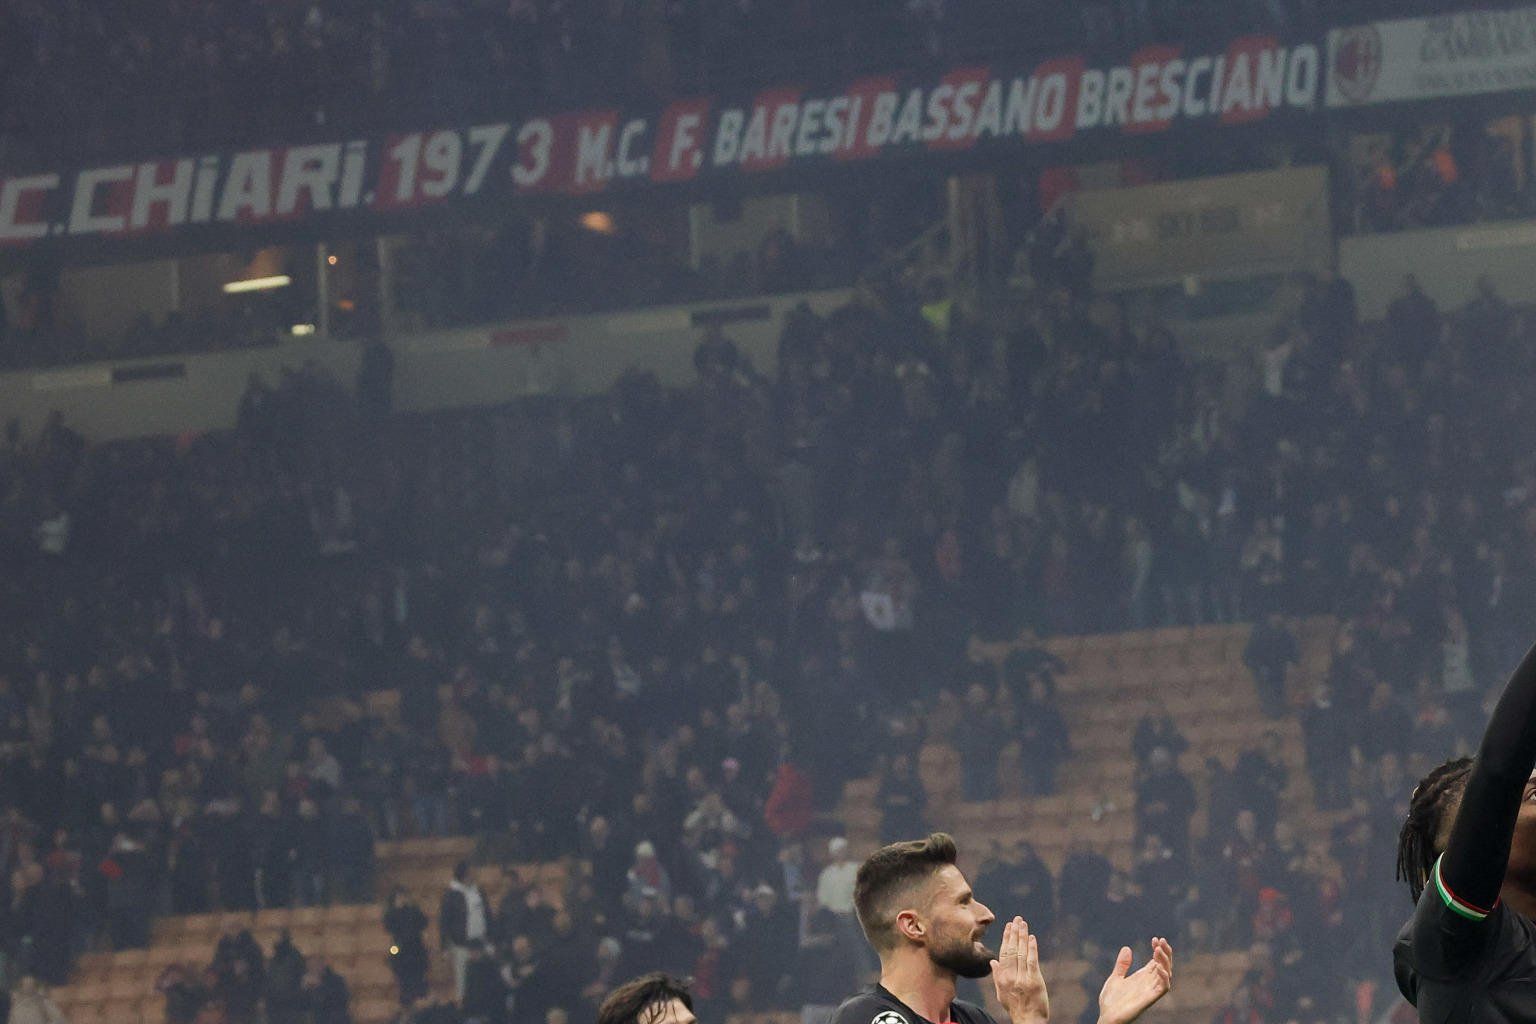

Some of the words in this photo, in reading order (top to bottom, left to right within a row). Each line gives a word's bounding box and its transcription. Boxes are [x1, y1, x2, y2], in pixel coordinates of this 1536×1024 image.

[391, 118, 553, 201] 1973
[713, 95, 861, 166] BARESI
[866, 74, 1067, 146] BASSANO
[1076, 44, 1319, 127] BRESCIANO
